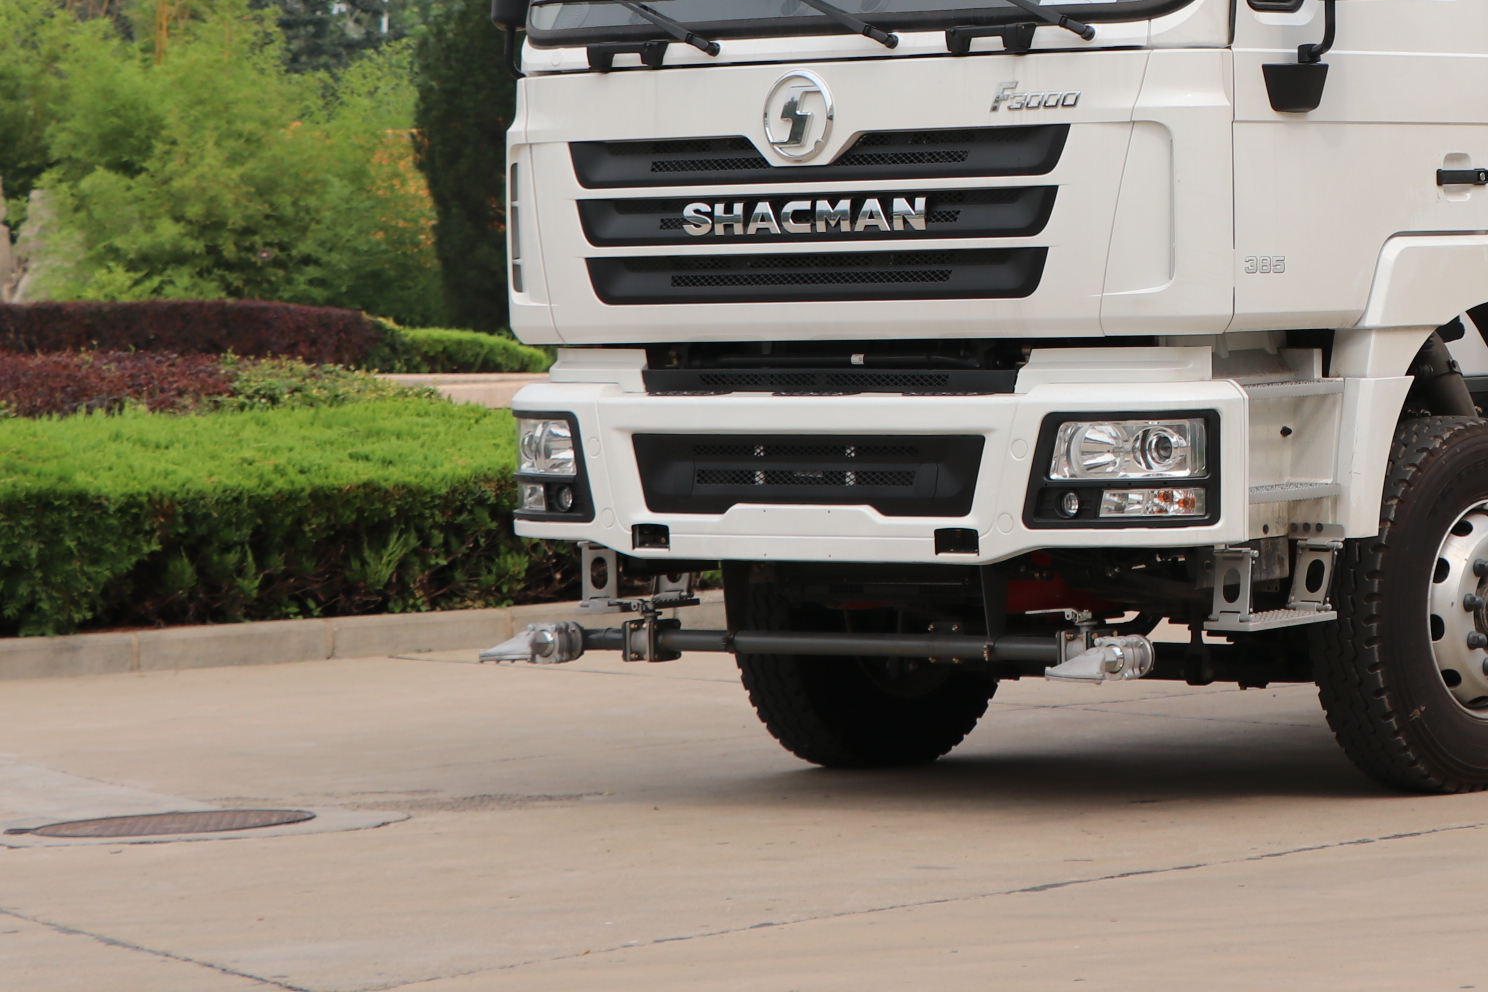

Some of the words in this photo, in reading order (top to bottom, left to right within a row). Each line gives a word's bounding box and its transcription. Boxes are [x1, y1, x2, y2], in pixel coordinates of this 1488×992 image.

[989, 81, 1081, 113] F3000
[682, 195, 928, 237] SHACMAN
[1244, 255, 1286, 274] 385
